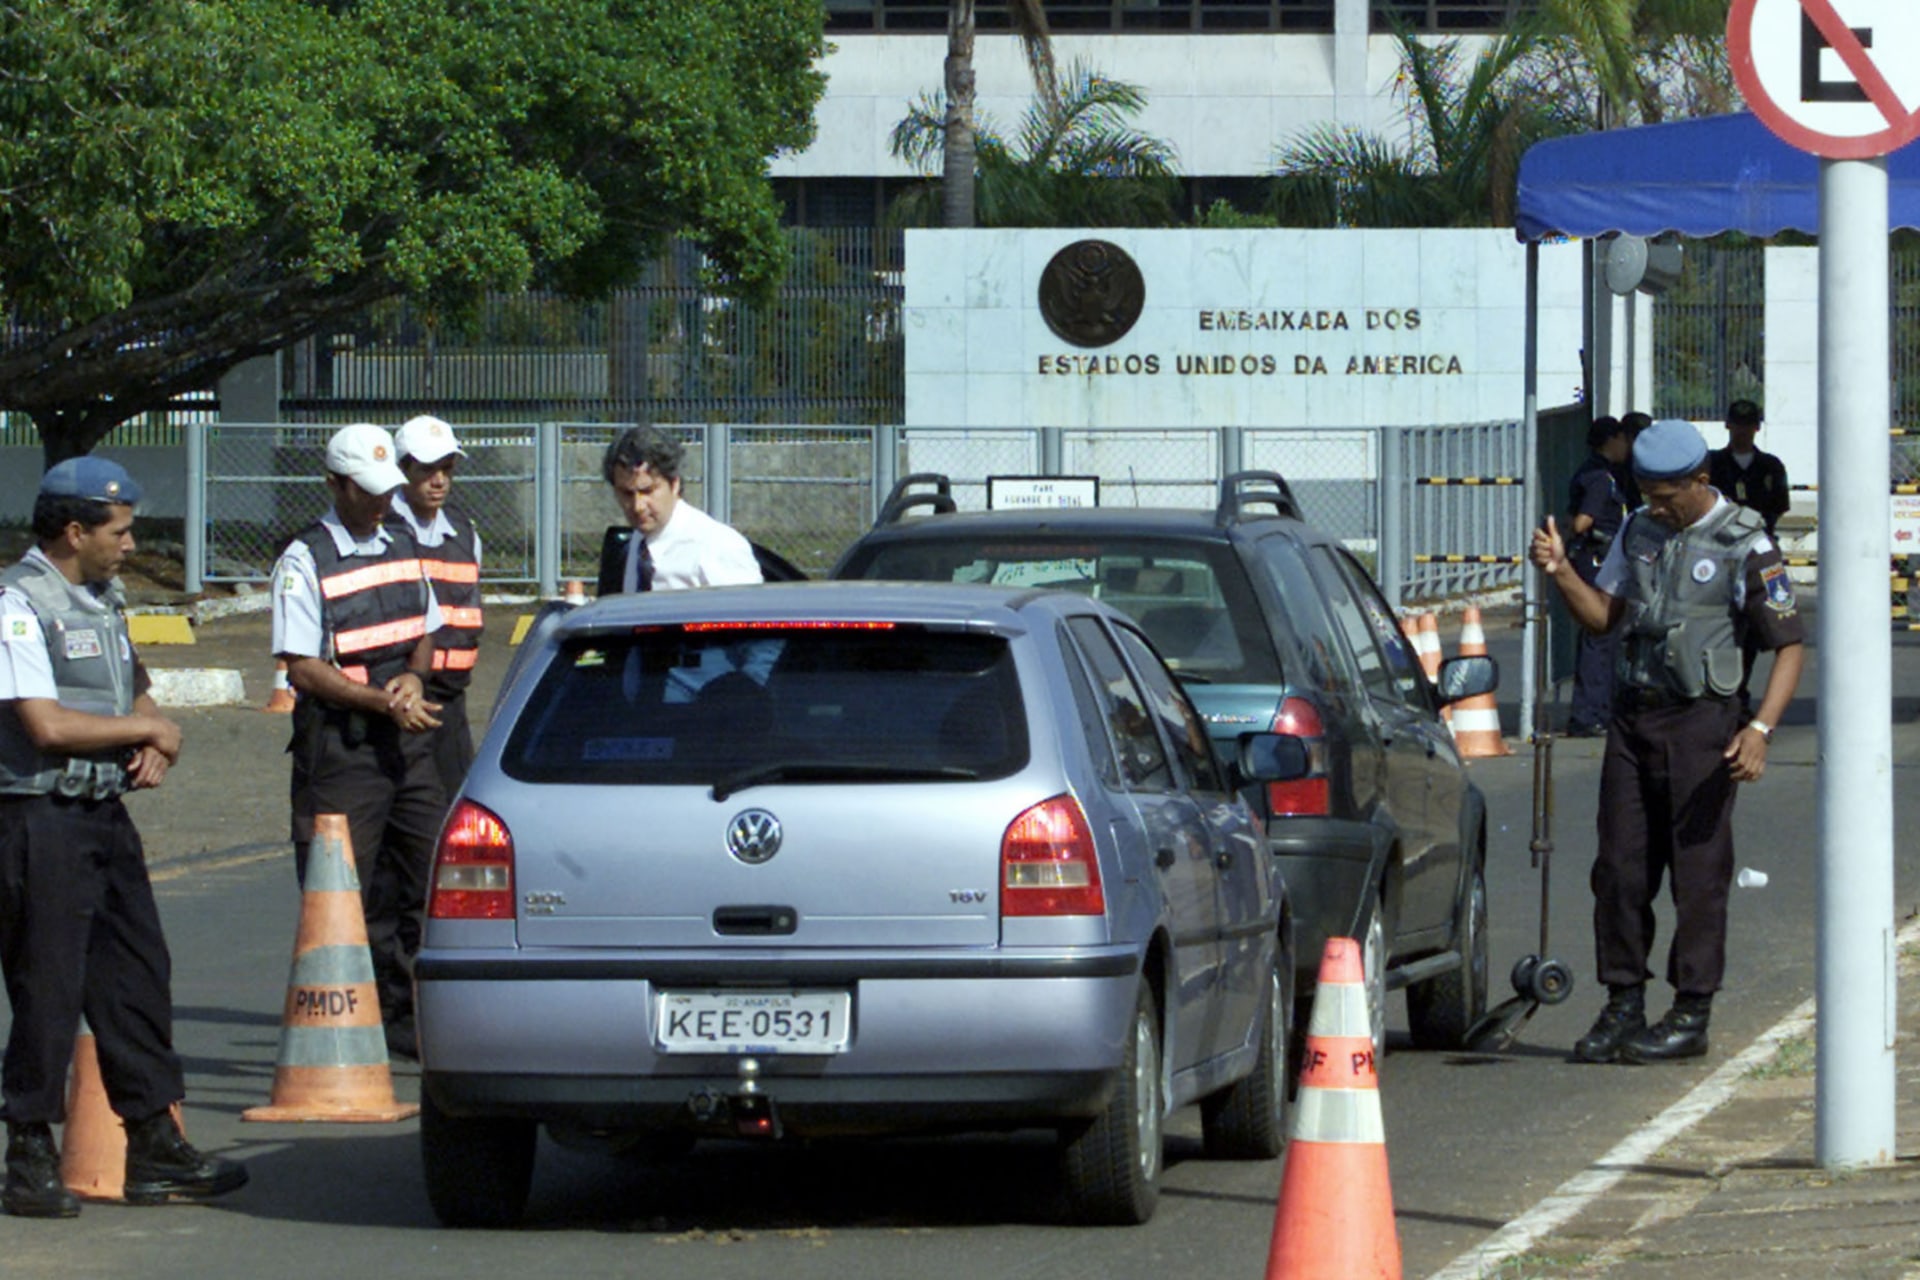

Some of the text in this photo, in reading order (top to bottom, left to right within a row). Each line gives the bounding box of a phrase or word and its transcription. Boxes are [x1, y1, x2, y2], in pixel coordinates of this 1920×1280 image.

[1199, 309, 1421, 331] EMBAIXADA DOS
[1038, 354, 1462, 376] ESTADOS UNIDOS DA AMERICA
[293, 988, 358, 1015] PMDF
